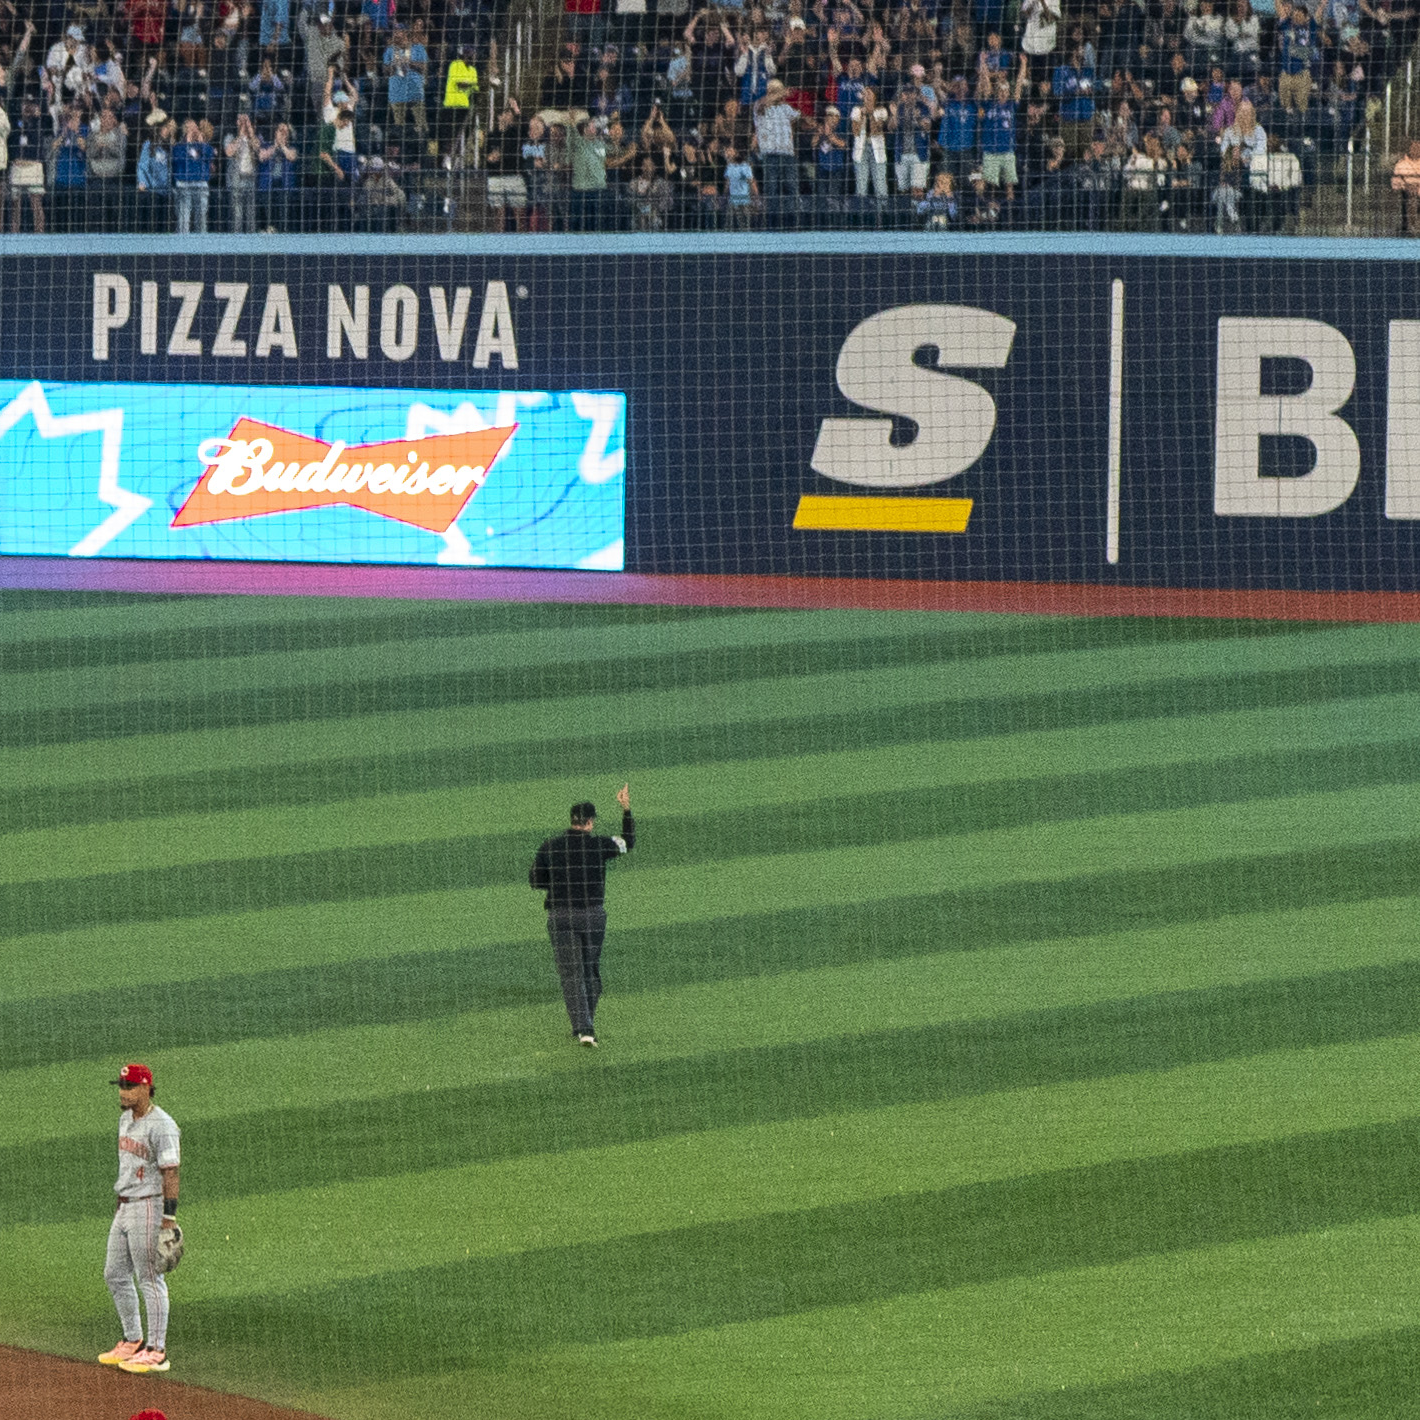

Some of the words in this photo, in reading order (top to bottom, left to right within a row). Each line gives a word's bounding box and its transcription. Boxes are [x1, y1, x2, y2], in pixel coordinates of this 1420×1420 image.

[91, 272, 298, 361] PIZZA
[327, 279, 519, 370] NOVA
[197, 434, 486, 497] Budweiser
[1213, 316, 1420, 521] B
